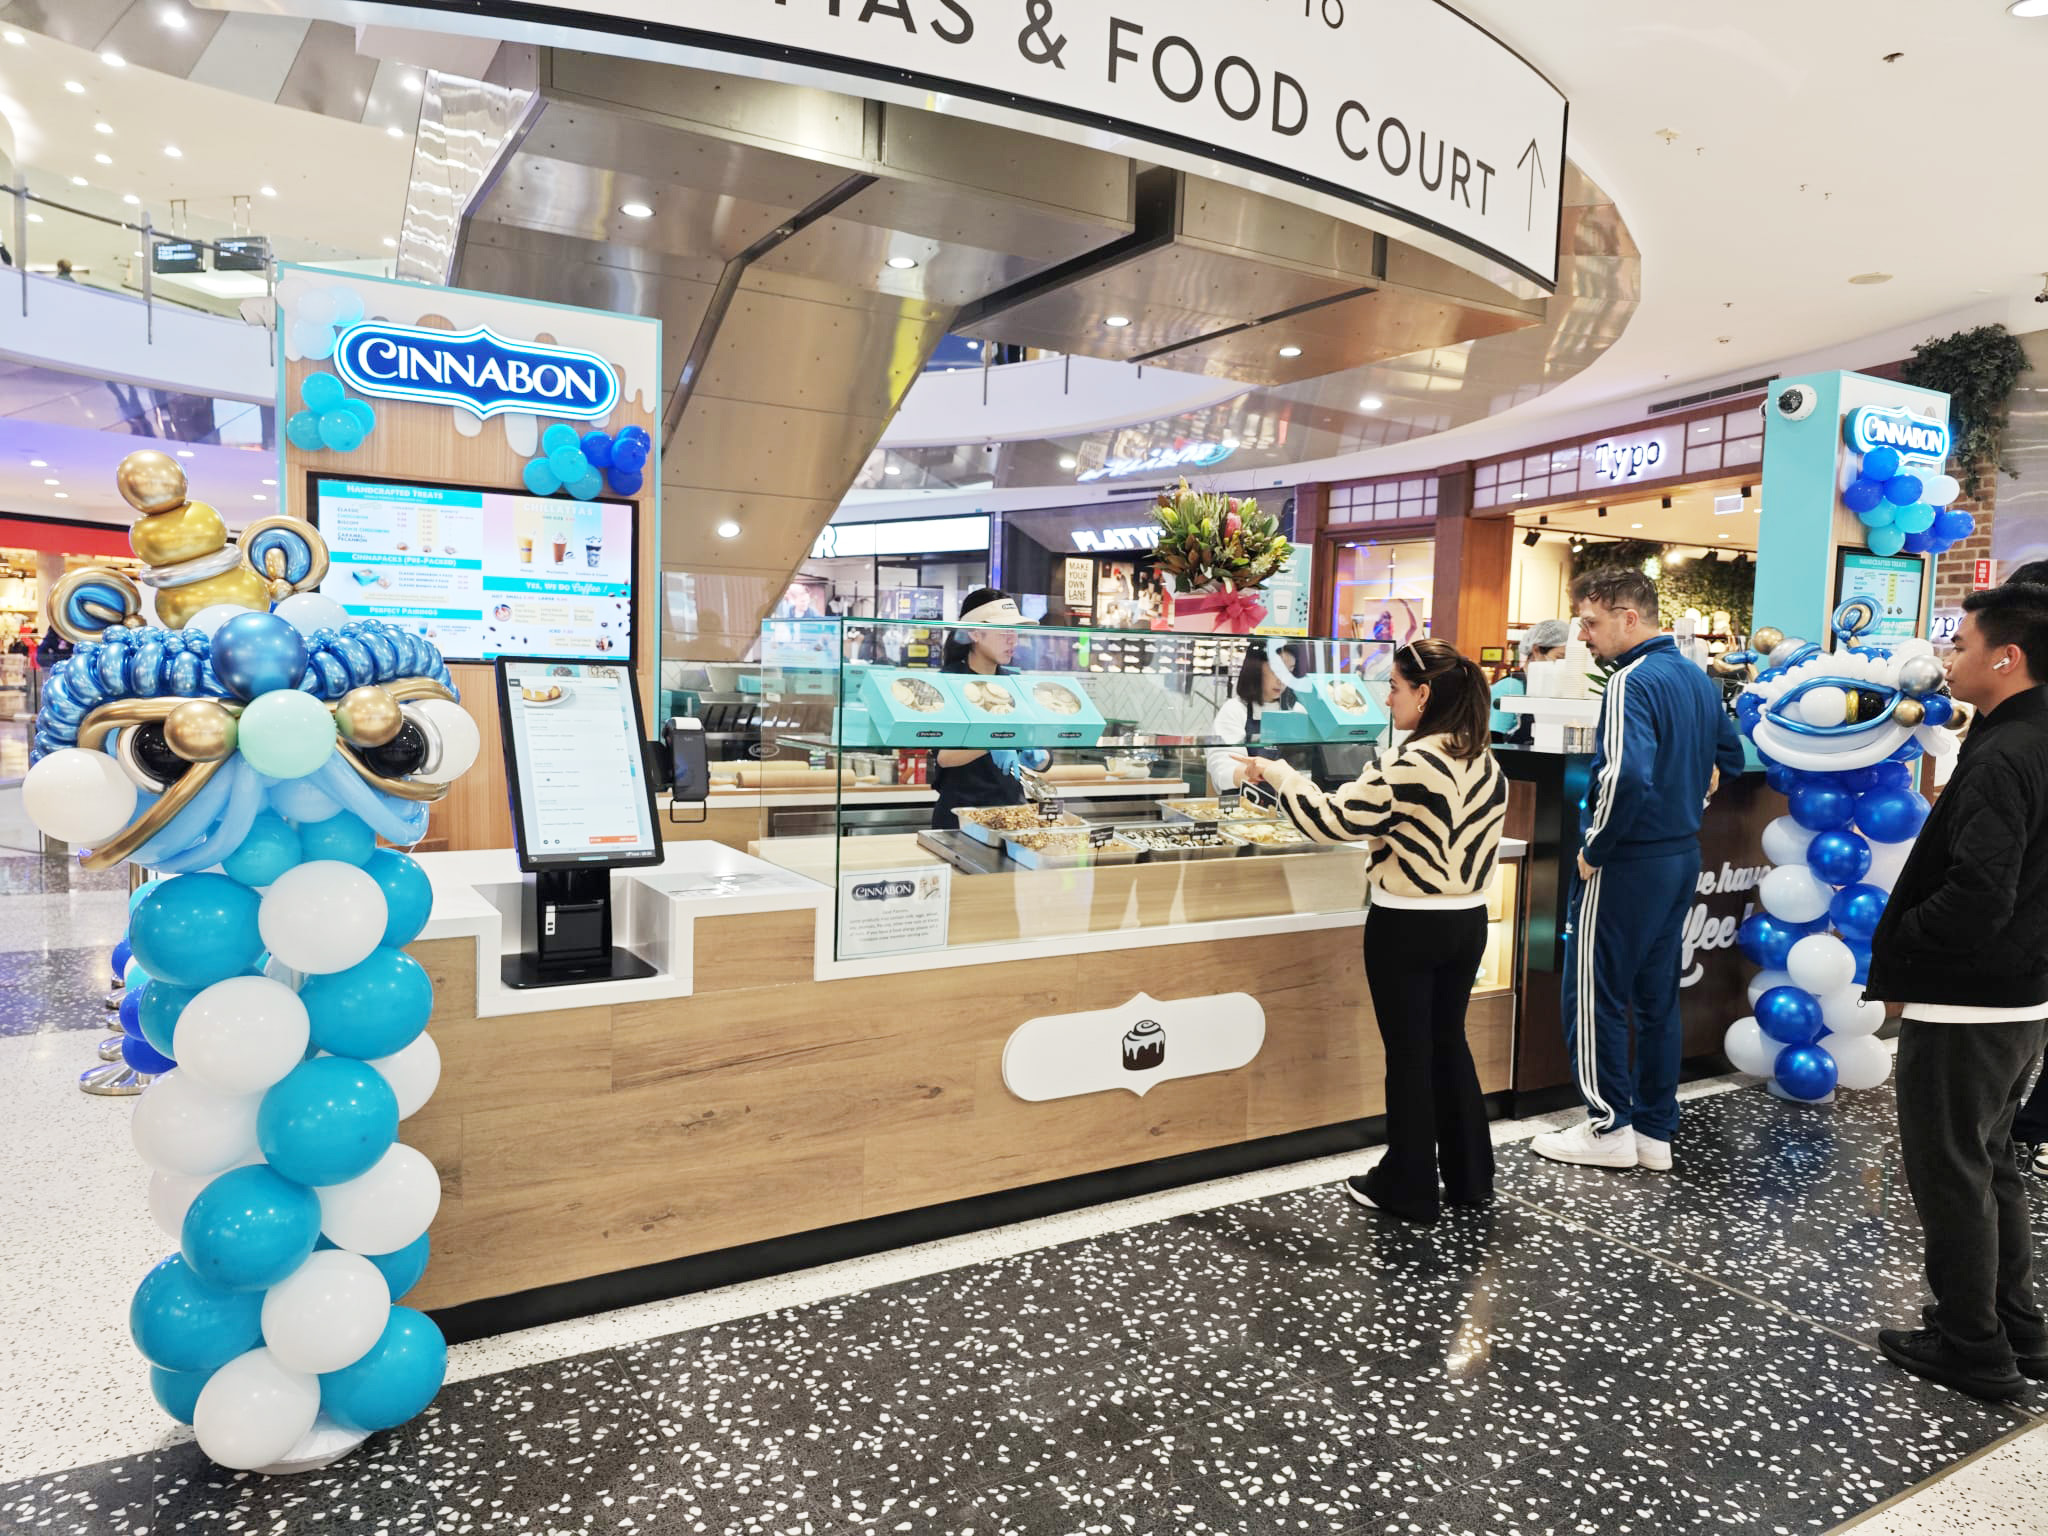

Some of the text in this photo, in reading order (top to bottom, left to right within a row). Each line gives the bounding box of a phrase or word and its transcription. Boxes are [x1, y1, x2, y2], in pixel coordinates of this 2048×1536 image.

[1018, 0, 1067, 70] &
[1108, 16, 1308, 136] FOOD
[1335, 100, 1495, 215] COURT
[358, 337, 597, 402] CINNABON
[1864, 416, 1943, 453] CINNABON
[1595, 441, 1660, 480] Typo
[1069, 561, 1089, 570] MAKE
[1069, 571, 1088, 580] YOUR
[1068, 581, 1085, 589] OWN
[1069, 590, 1087, 601] LANE
[855, 884, 912, 898] CINNABON
